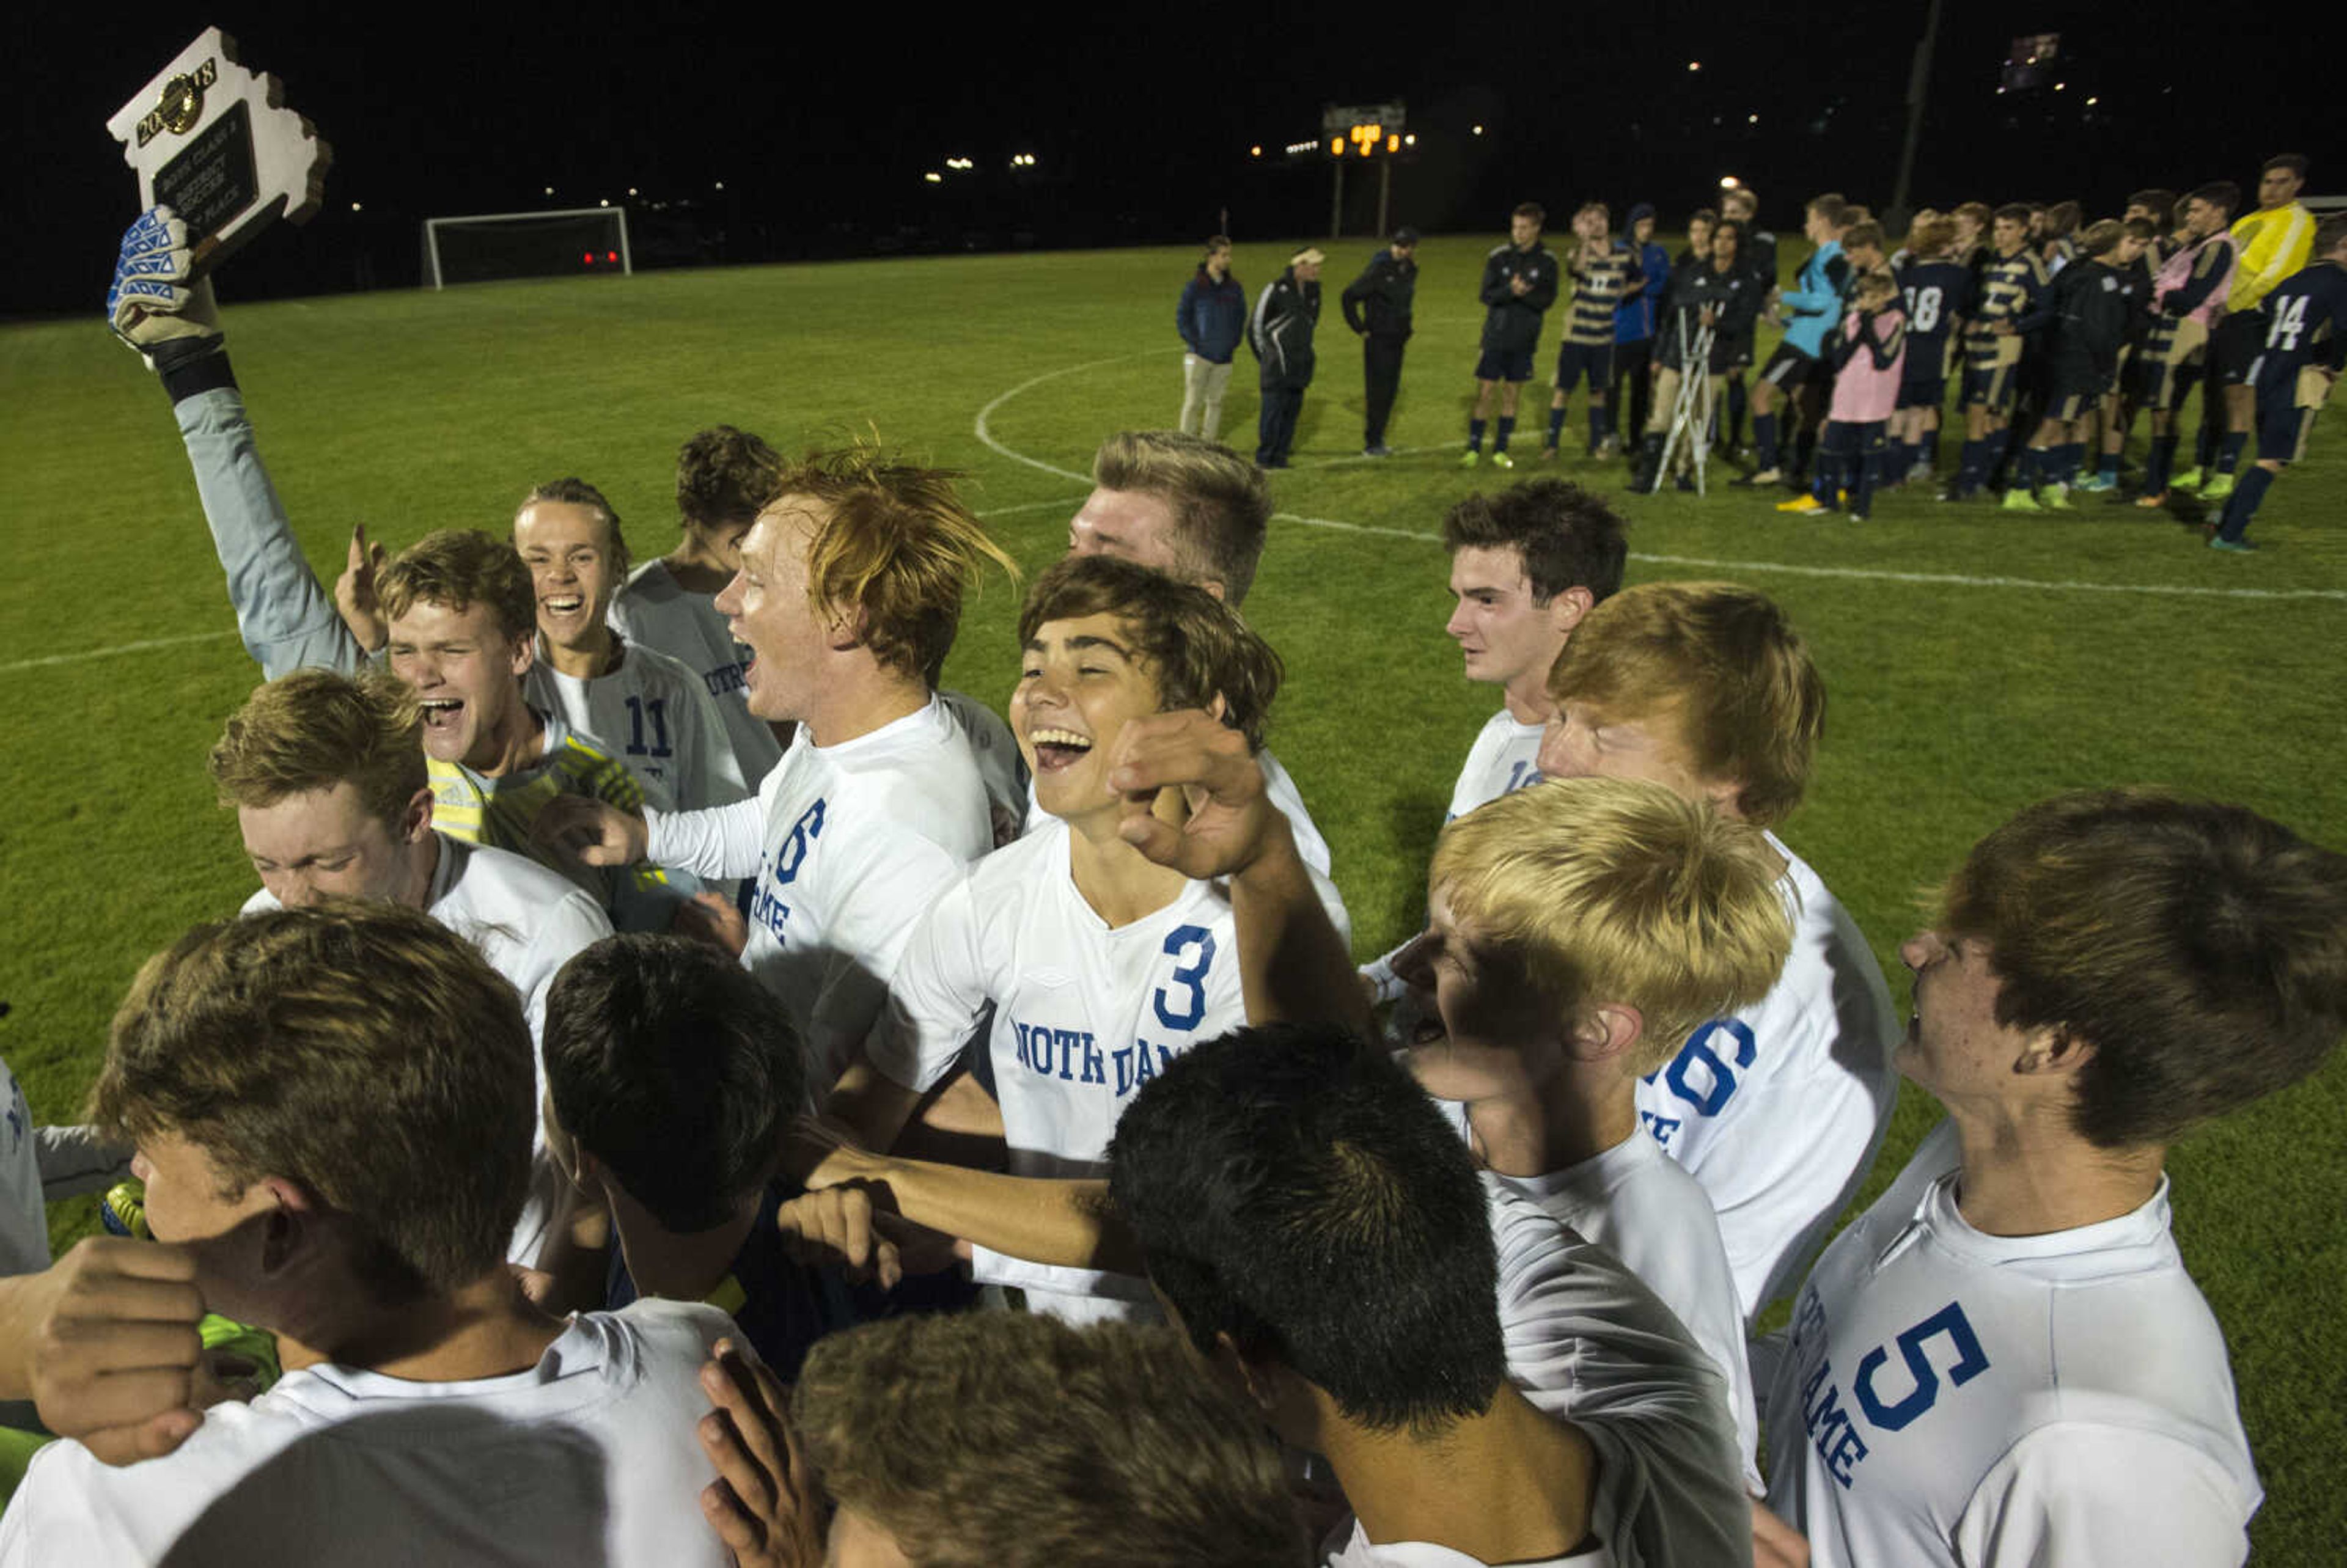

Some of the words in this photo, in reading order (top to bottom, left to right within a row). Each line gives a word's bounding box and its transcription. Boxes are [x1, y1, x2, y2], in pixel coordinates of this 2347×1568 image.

[1903, 286, 1943, 332] 18
[2264, 294, 2311, 351] 14
[625, 695, 672, 757] 11
[1153, 924, 1216, 1031] 3
[1017, 1022, 1106, 1084] NOTR
[1643, 1017, 1757, 1117] 6
[1854, 1300, 1991, 1432] 5
[1804, 1358, 1870, 1490] AME
